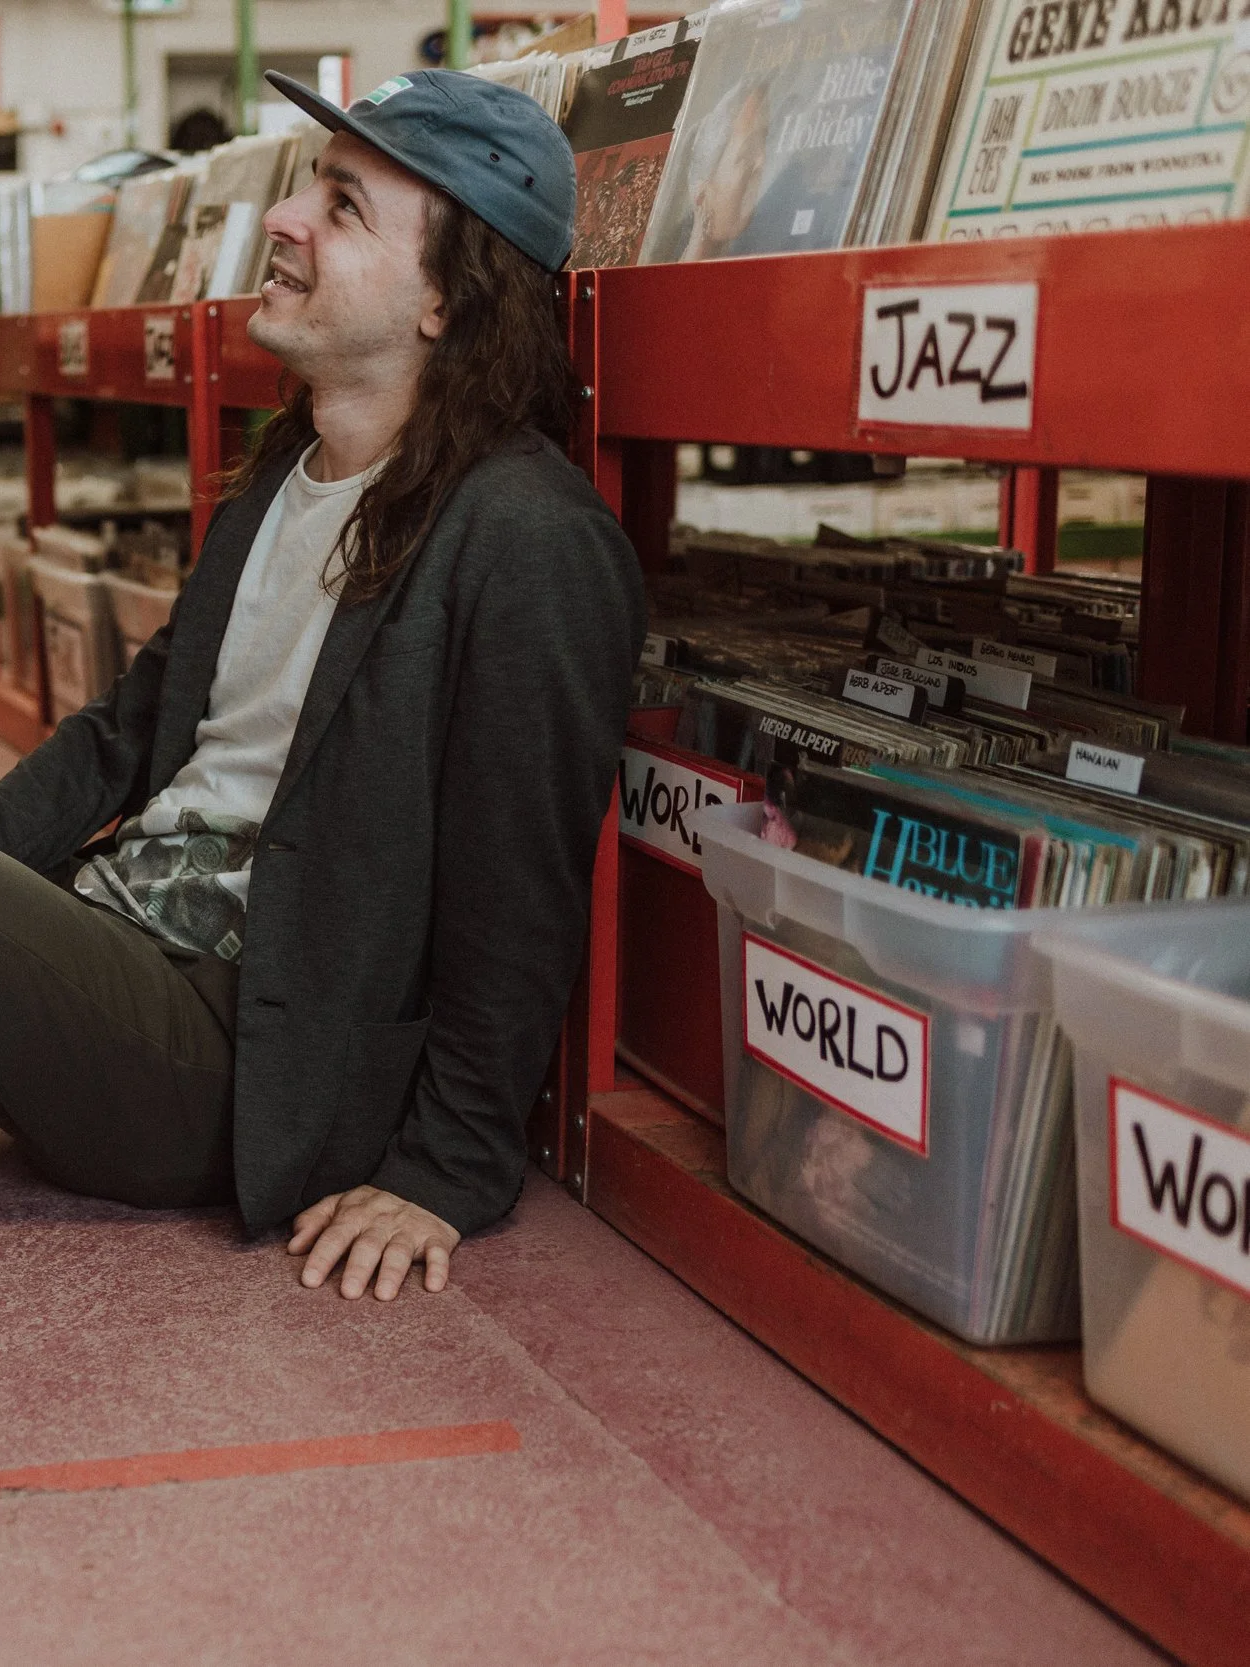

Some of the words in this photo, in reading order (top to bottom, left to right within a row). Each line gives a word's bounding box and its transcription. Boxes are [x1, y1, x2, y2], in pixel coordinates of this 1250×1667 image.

[1007, 0, 1117, 63] GENE
[817, 55, 885, 104] Billie
[1042, 80, 1111, 132] DRUM
[1108, 66, 1201, 122] BOOGIE
[775, 103, 874, 153] Holiday
[871, 298, 1028, 404] JAZZ
[849, 674, 869, 690] HERB
[871, 680, 903, 697] ALPERT
[927, 653, 943, 667] LOS
[949, 659, 978, 676] INDIOS
[759, 716, 791, 740] HERB
[791, 728, 840, 757] ALPERT
[907, 818, 1017, 895] BLUE
[755, 979, 908, 1082] WORLD
